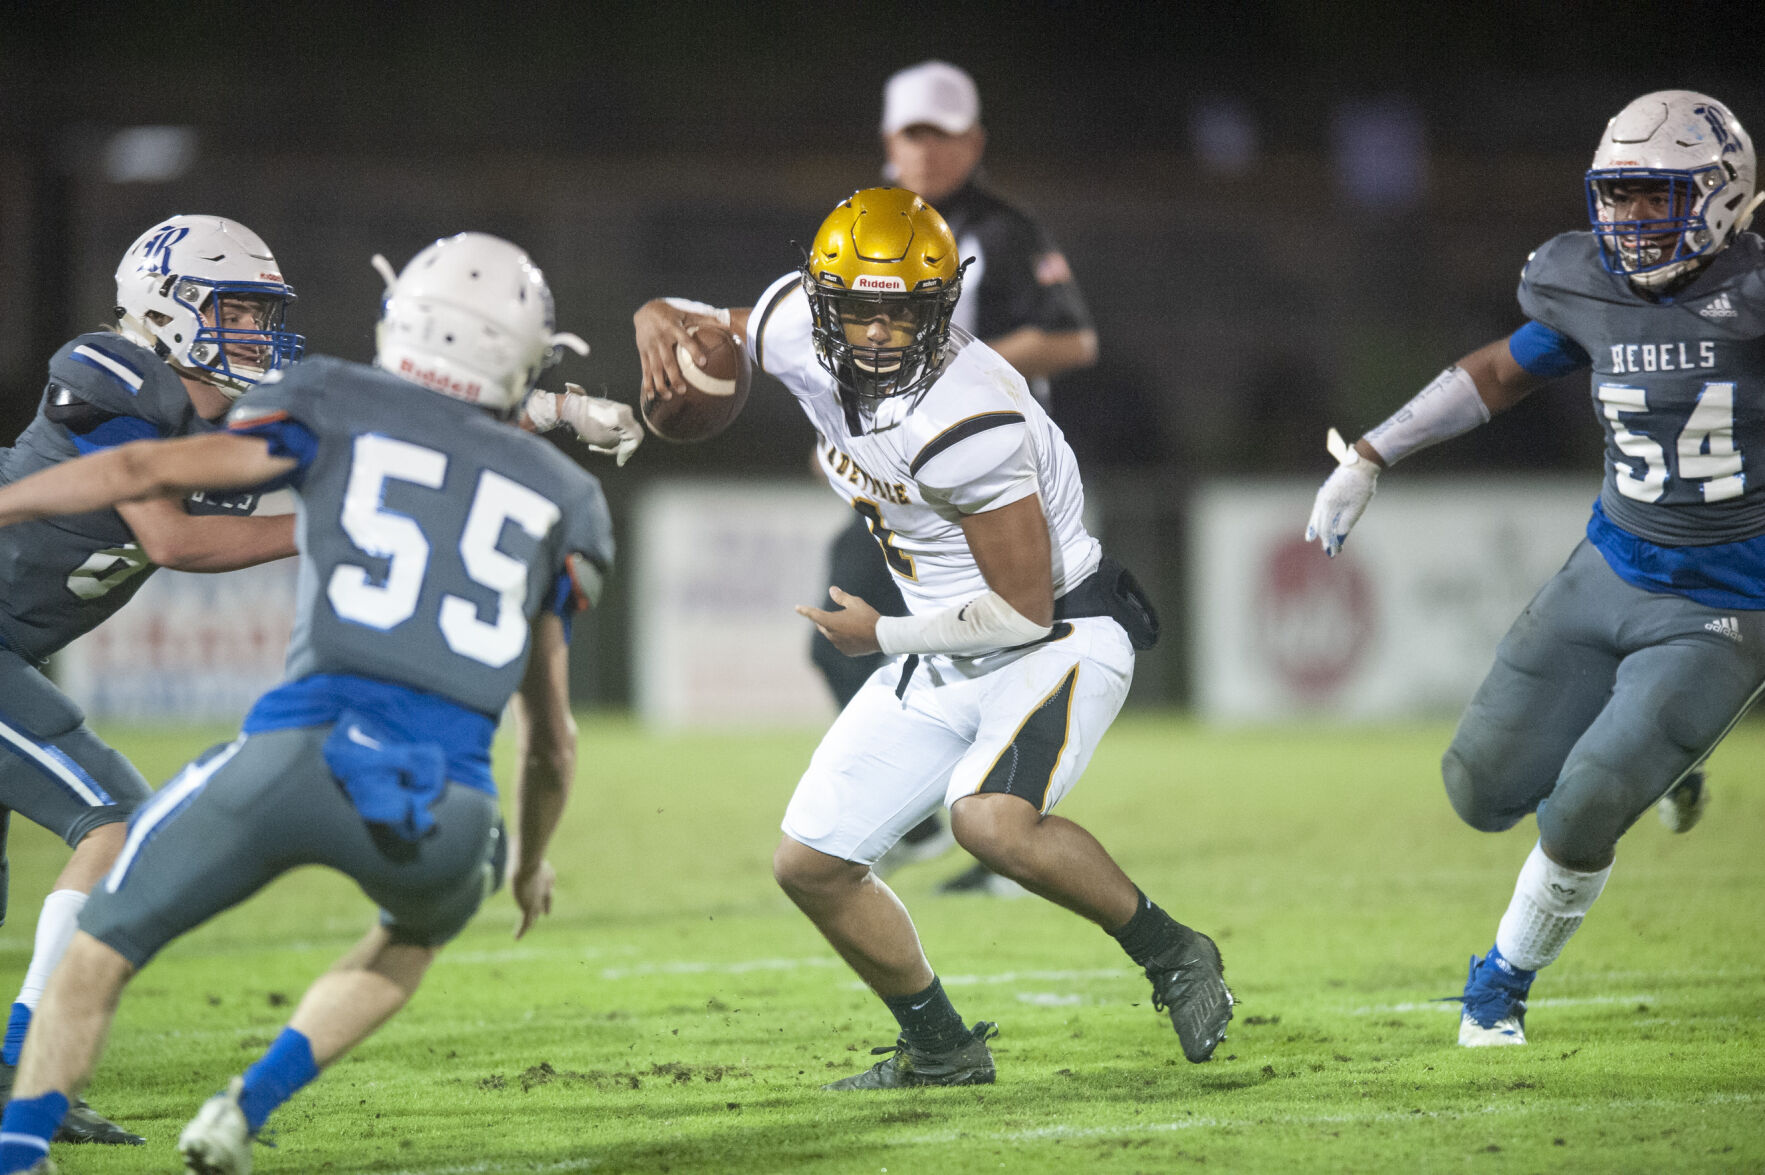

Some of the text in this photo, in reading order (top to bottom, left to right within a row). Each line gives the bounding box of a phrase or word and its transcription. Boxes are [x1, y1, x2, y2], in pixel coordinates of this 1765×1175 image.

[137, 226, 189, 276] R
[859, 278, 900, 289] Riddell
[1611, 341, 1715, 373] REBELS
[1599, 382, 1746, 503] 54
[327, 432, 562, 668] 55
